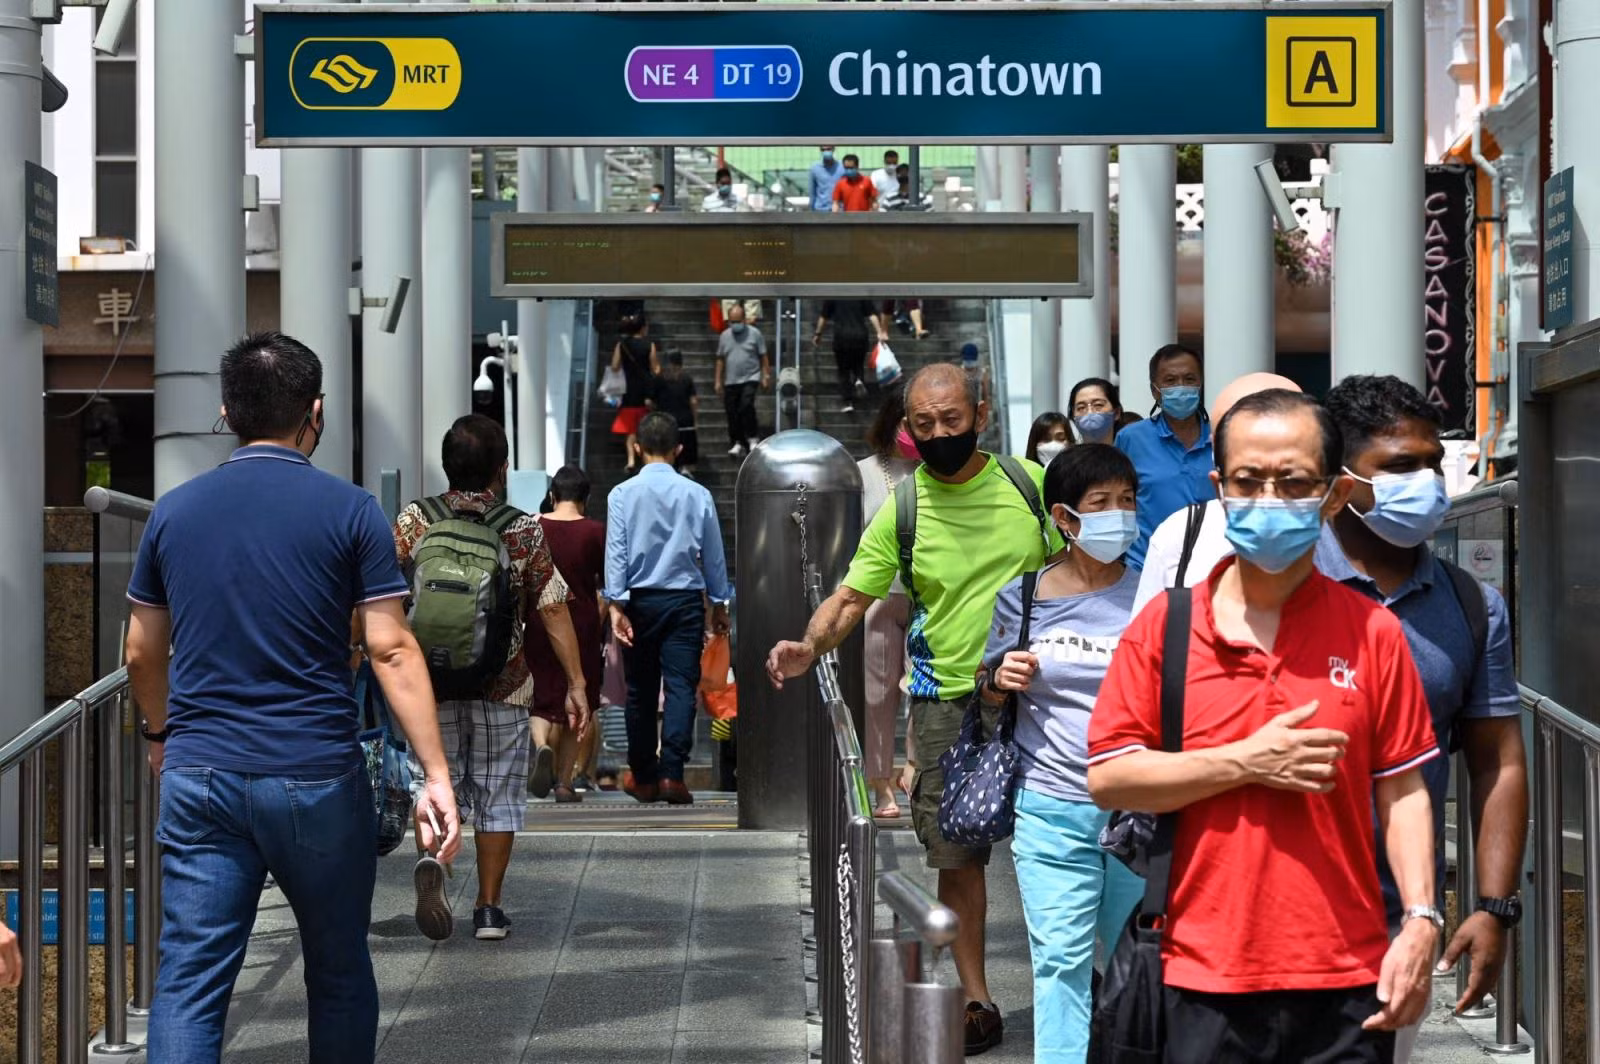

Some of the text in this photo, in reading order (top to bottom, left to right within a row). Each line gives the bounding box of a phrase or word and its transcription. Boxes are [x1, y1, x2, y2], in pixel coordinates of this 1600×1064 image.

[403, 65, 450, 84] MRT
[643, 64, 699, 86] NE 4
[723, 63, 792, 85] DT 19
[828, 48, 1103, 98] Chinatown
[1303, 50, 1339, 94] A
[93, 288, 140, 336] 車
[1425, 192, 1451, 410] CASANOVA
[1330, 667, 1358, 690] CK
